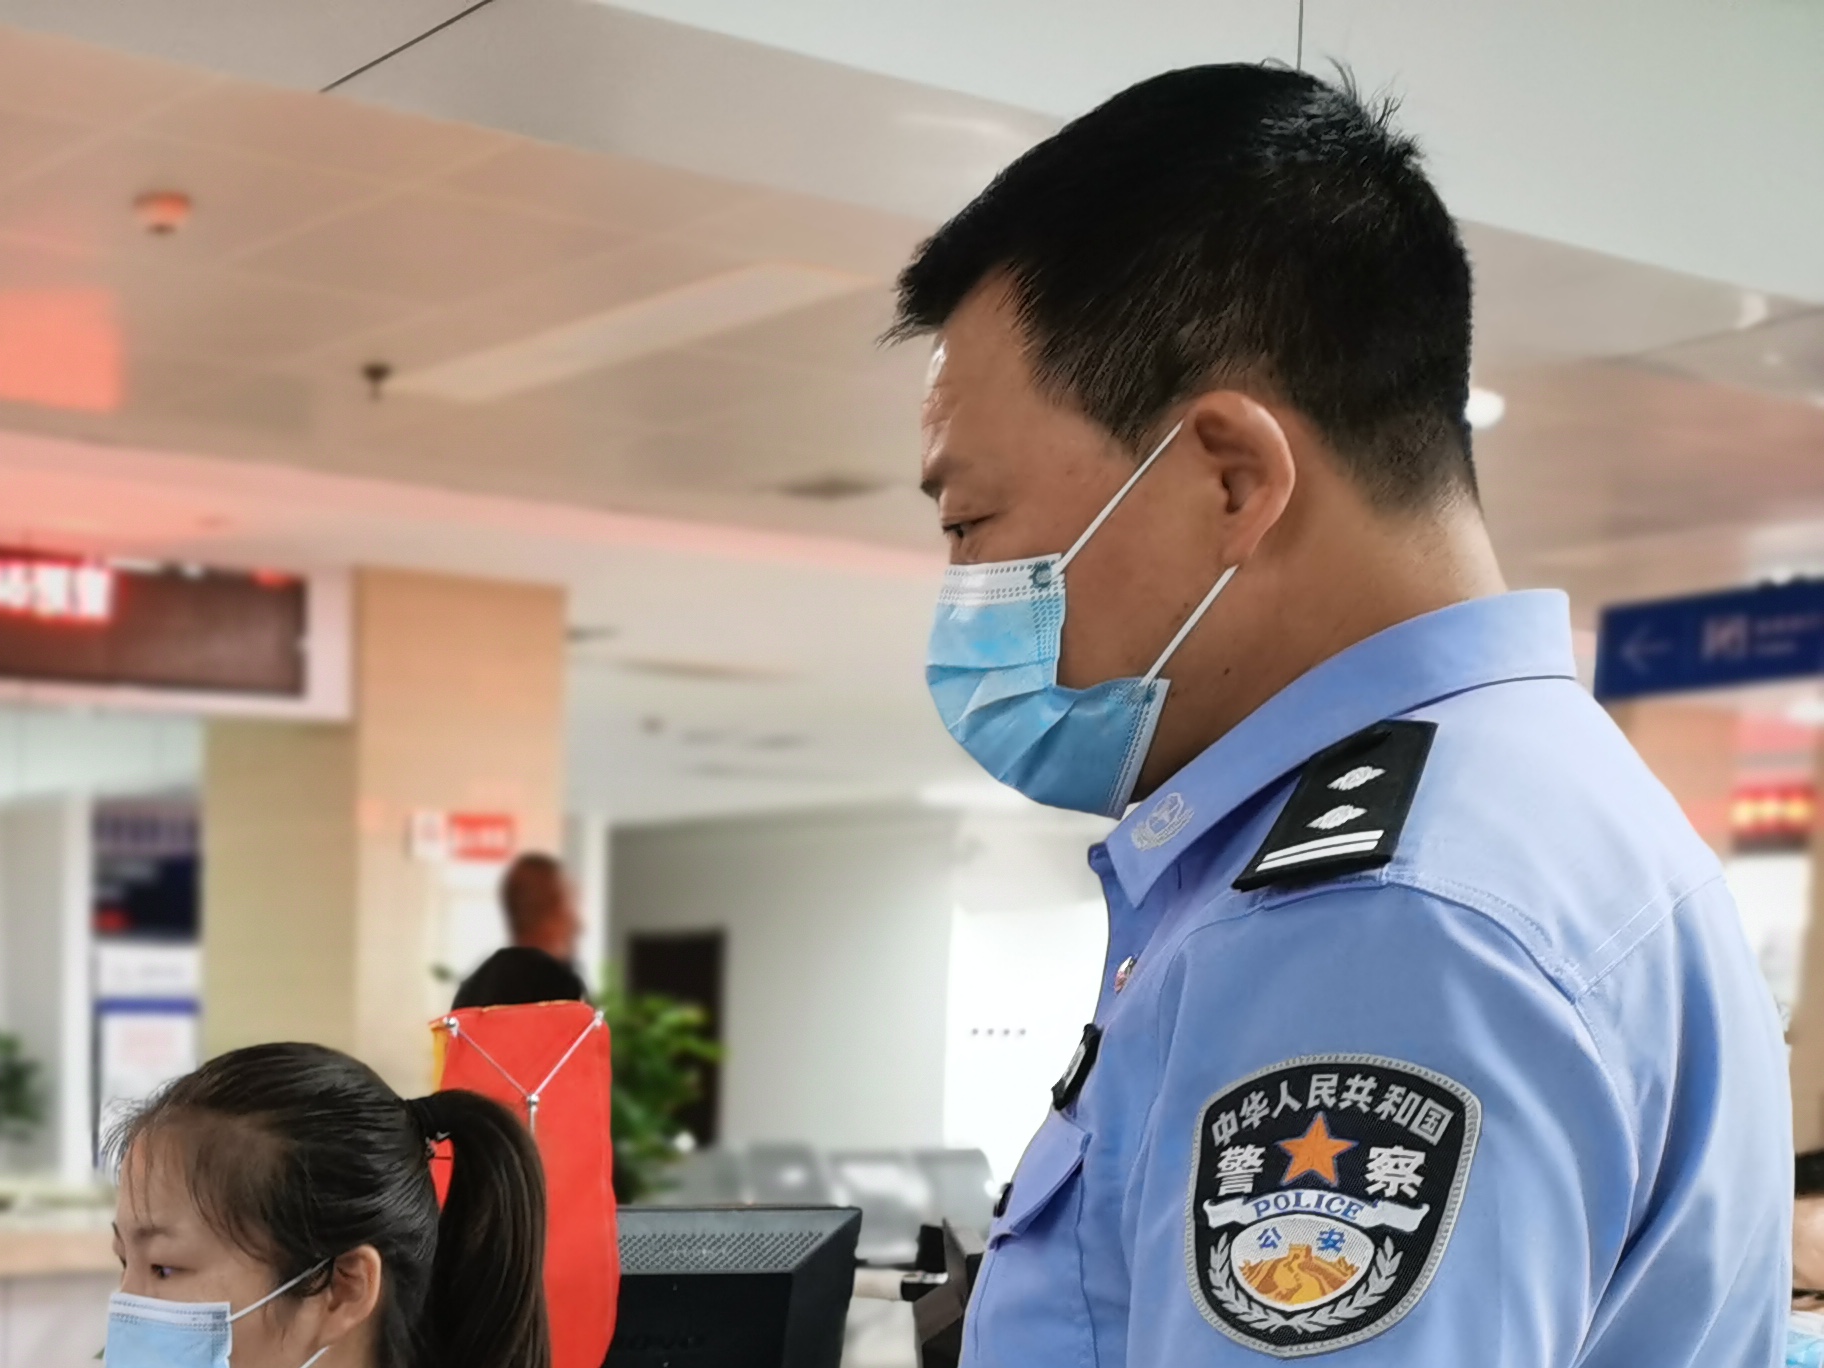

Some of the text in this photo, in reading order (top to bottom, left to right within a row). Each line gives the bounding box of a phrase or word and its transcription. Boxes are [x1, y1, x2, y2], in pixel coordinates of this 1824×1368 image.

[1211, 1073, 1454, 1146] 中华人民共和国
[1253, 1192, 1366, 1221] POLICE
